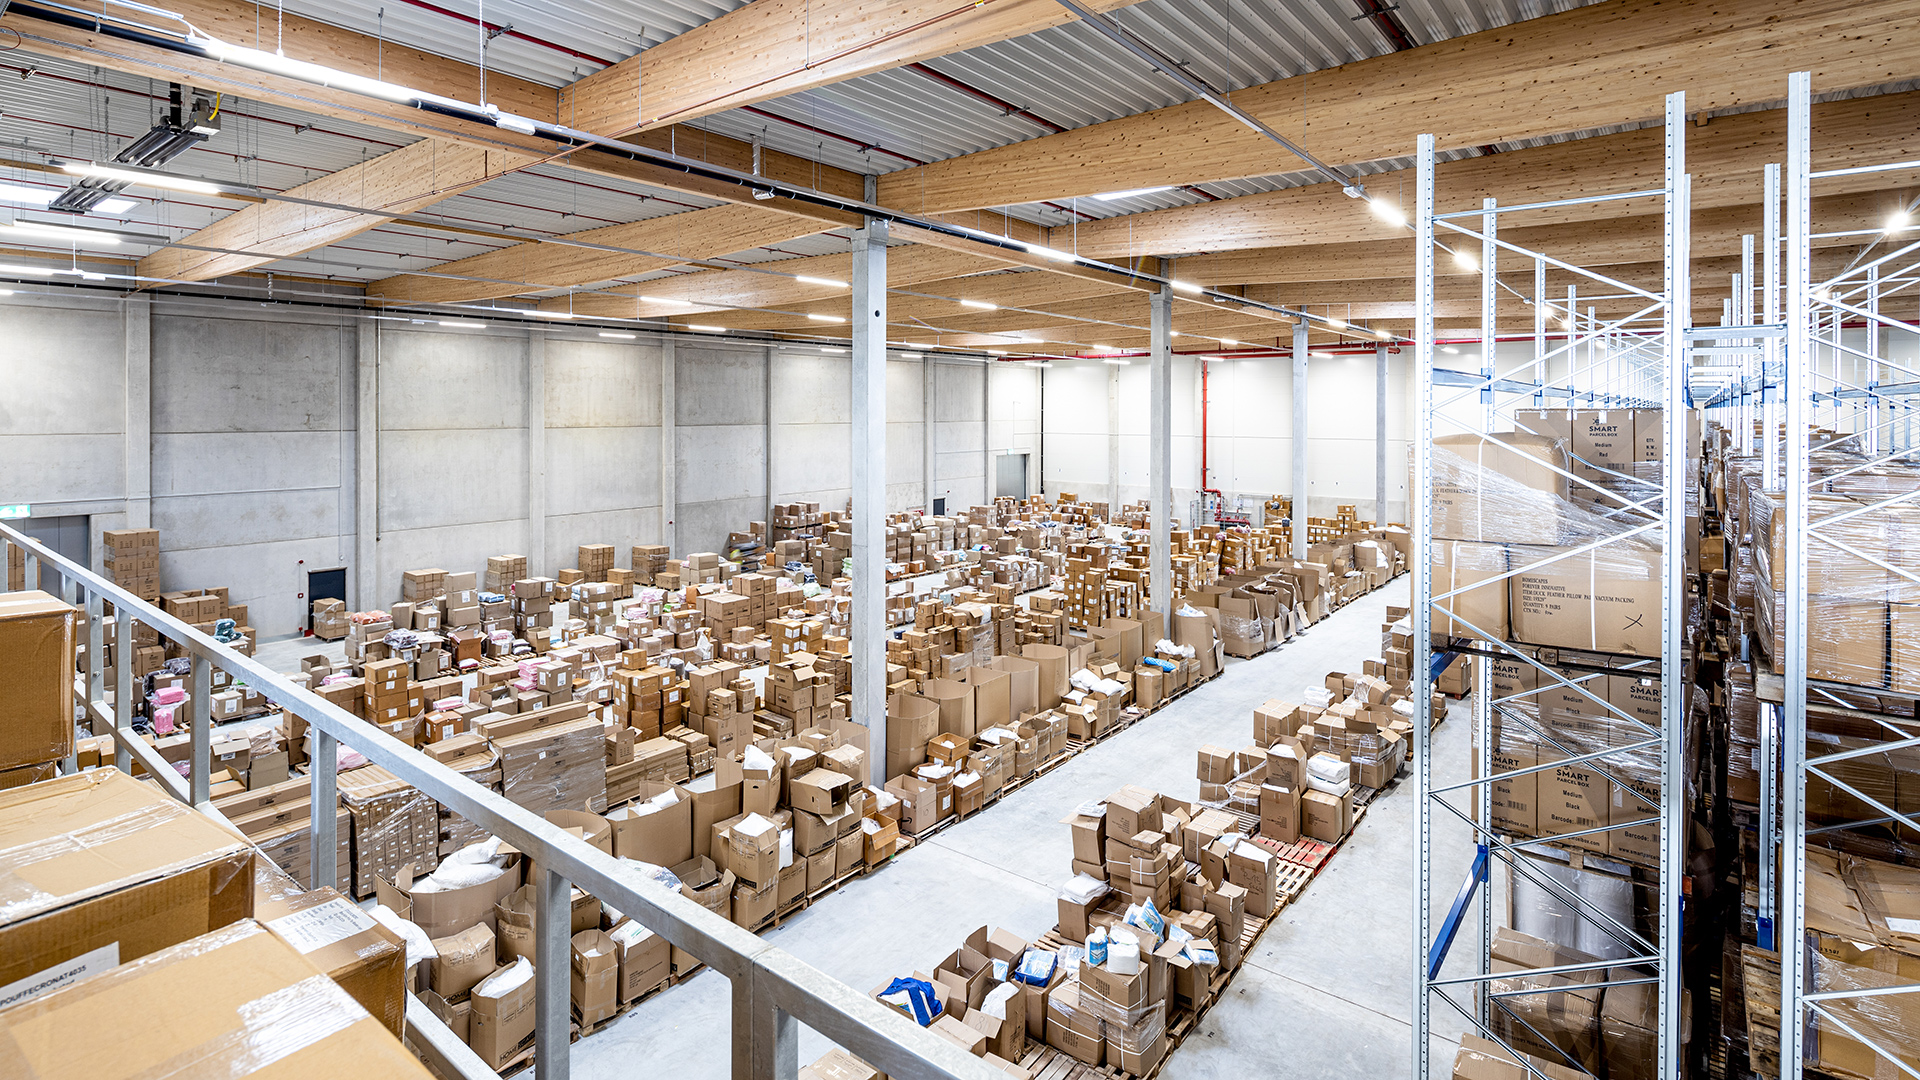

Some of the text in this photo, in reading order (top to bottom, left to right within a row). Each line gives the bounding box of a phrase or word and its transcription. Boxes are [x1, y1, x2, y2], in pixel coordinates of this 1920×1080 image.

[1630, 686, 1662, 696] SMAR
[1631, 694, 1652, 702] PARCEL
[1637, 707, 1658, 716] Medium
[1556, 769, 1590, 782] SMART
[1556, 776, 1578, 785] PARCEL
[1497, 786, 1510, 794] Black
[1562, 790, 1582, 799] Medium
[1630, 784, 1661, 796] SMAR
[1566, 802, 1580, 810] Black
[1636, 806, 1658, 815] Medium
[0, 965, 87, 1007] POUFFECRONAT4035
[500, 1043, 518, 1062] HOME
